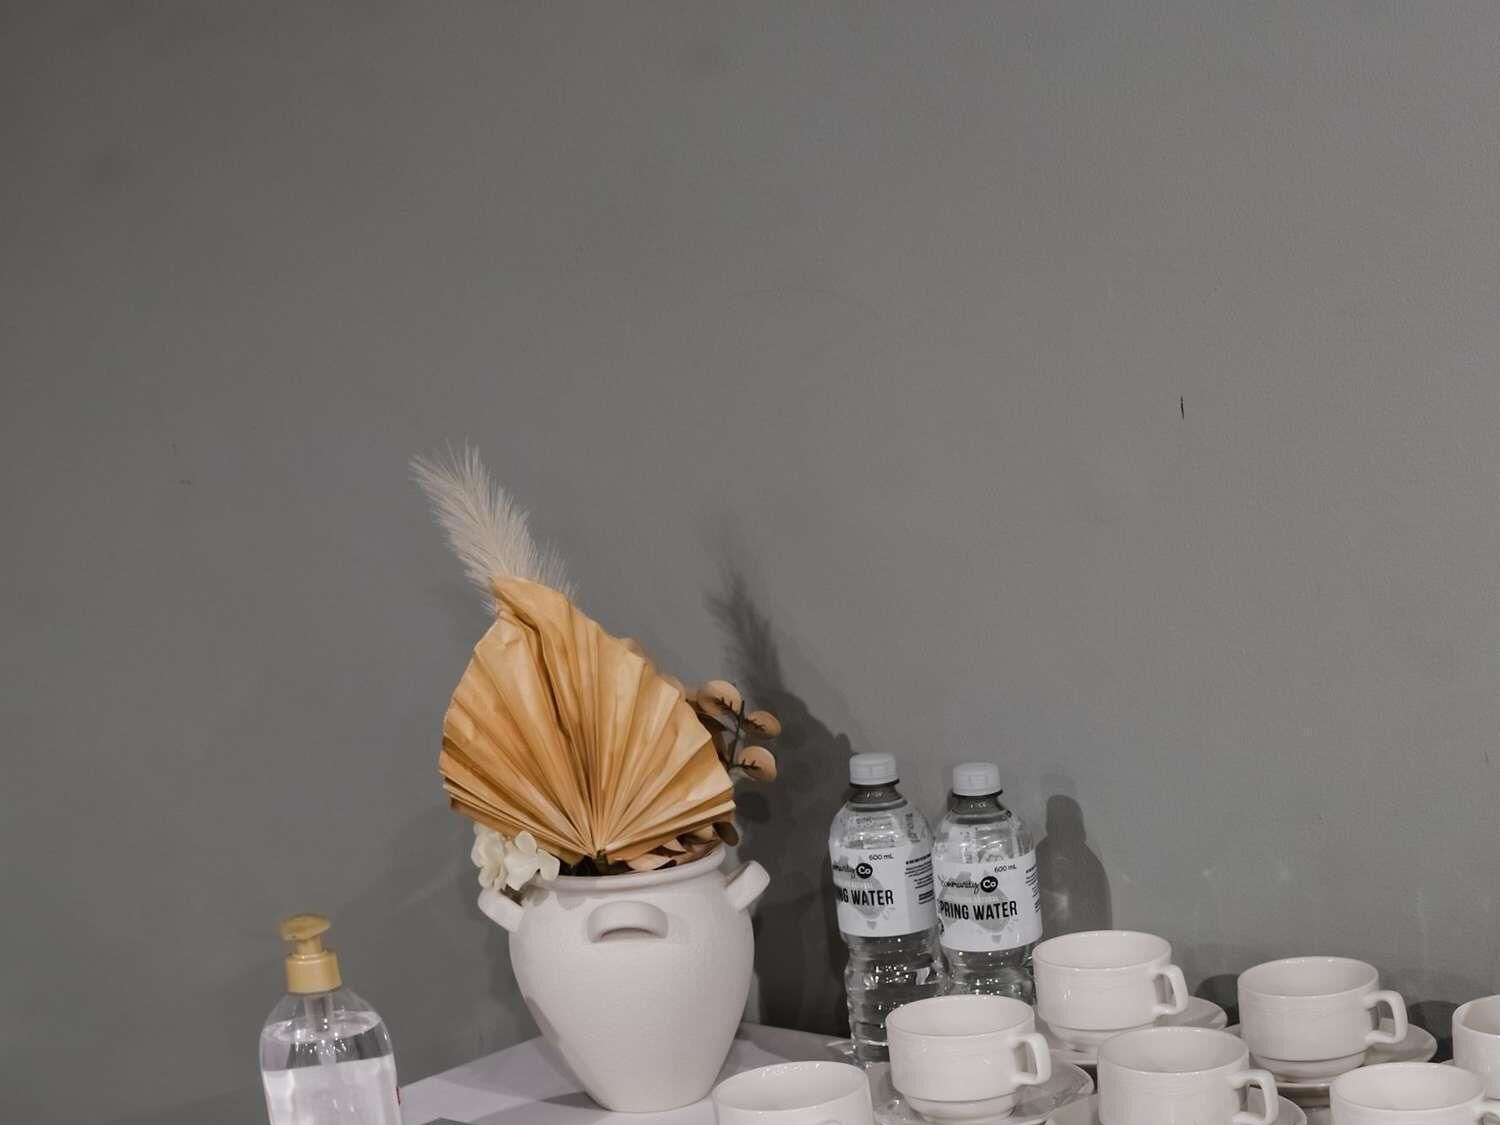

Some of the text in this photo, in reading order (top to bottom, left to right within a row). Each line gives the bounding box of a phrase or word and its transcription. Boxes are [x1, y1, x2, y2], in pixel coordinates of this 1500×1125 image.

[851, 889, 894, 906] WATER
[939, 900, 1017, 920] PRING WATER
